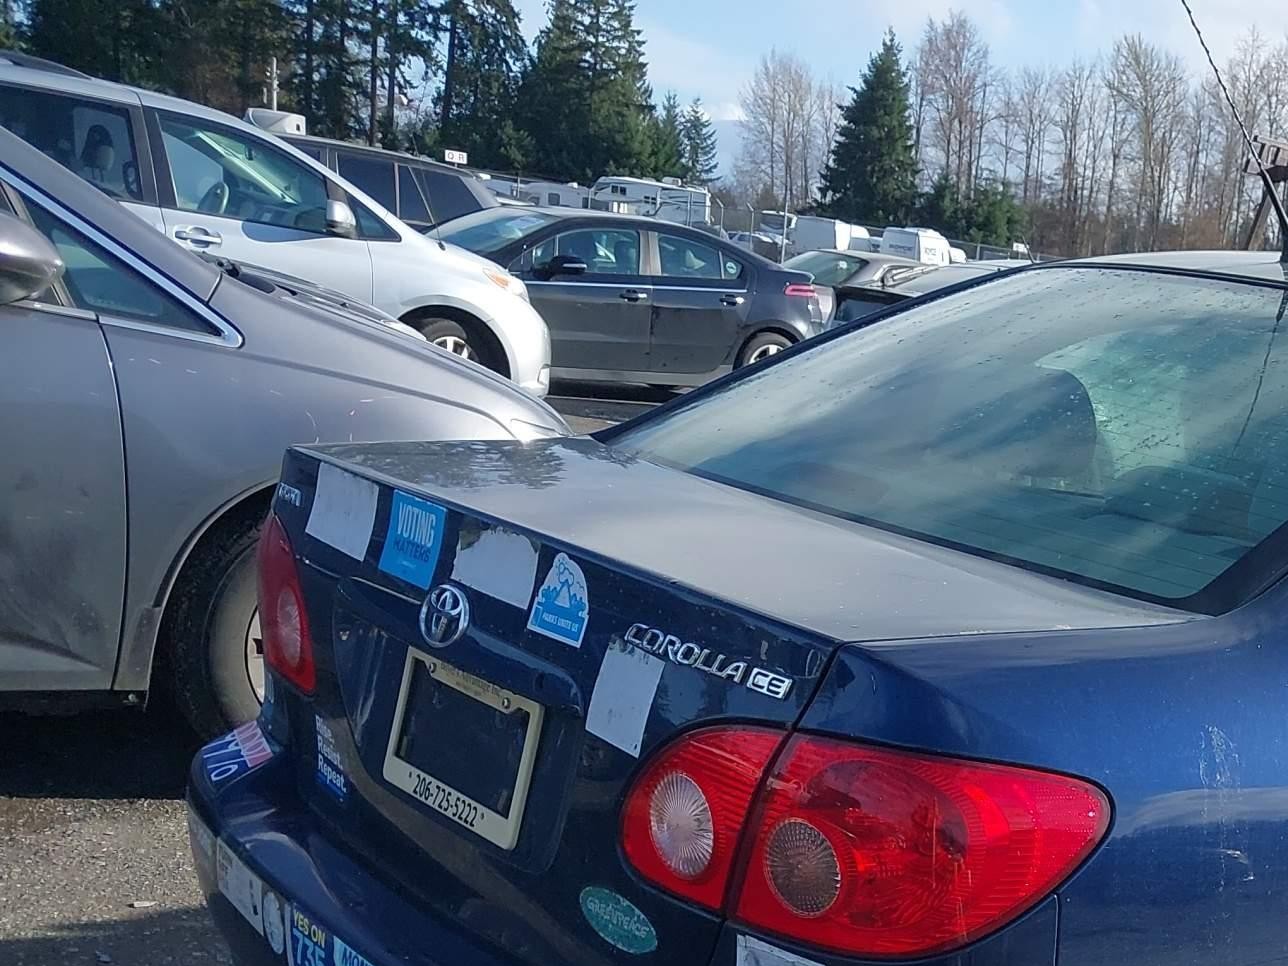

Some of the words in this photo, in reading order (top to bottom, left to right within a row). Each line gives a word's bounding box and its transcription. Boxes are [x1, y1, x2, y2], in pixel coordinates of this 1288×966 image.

[397, 501, 436, 548] VOTING
[393, 538, 431, 563] MATTERS
[624, 623, 748, 684] COROLLA
[749, 669, 790, 698] CE
[318, 753, 347, 793] Repeat.
[412, 774, 479, 828] 206-725-5222
[293, 909, 309, 936] YES
[311, 924, 326, 949] ON
